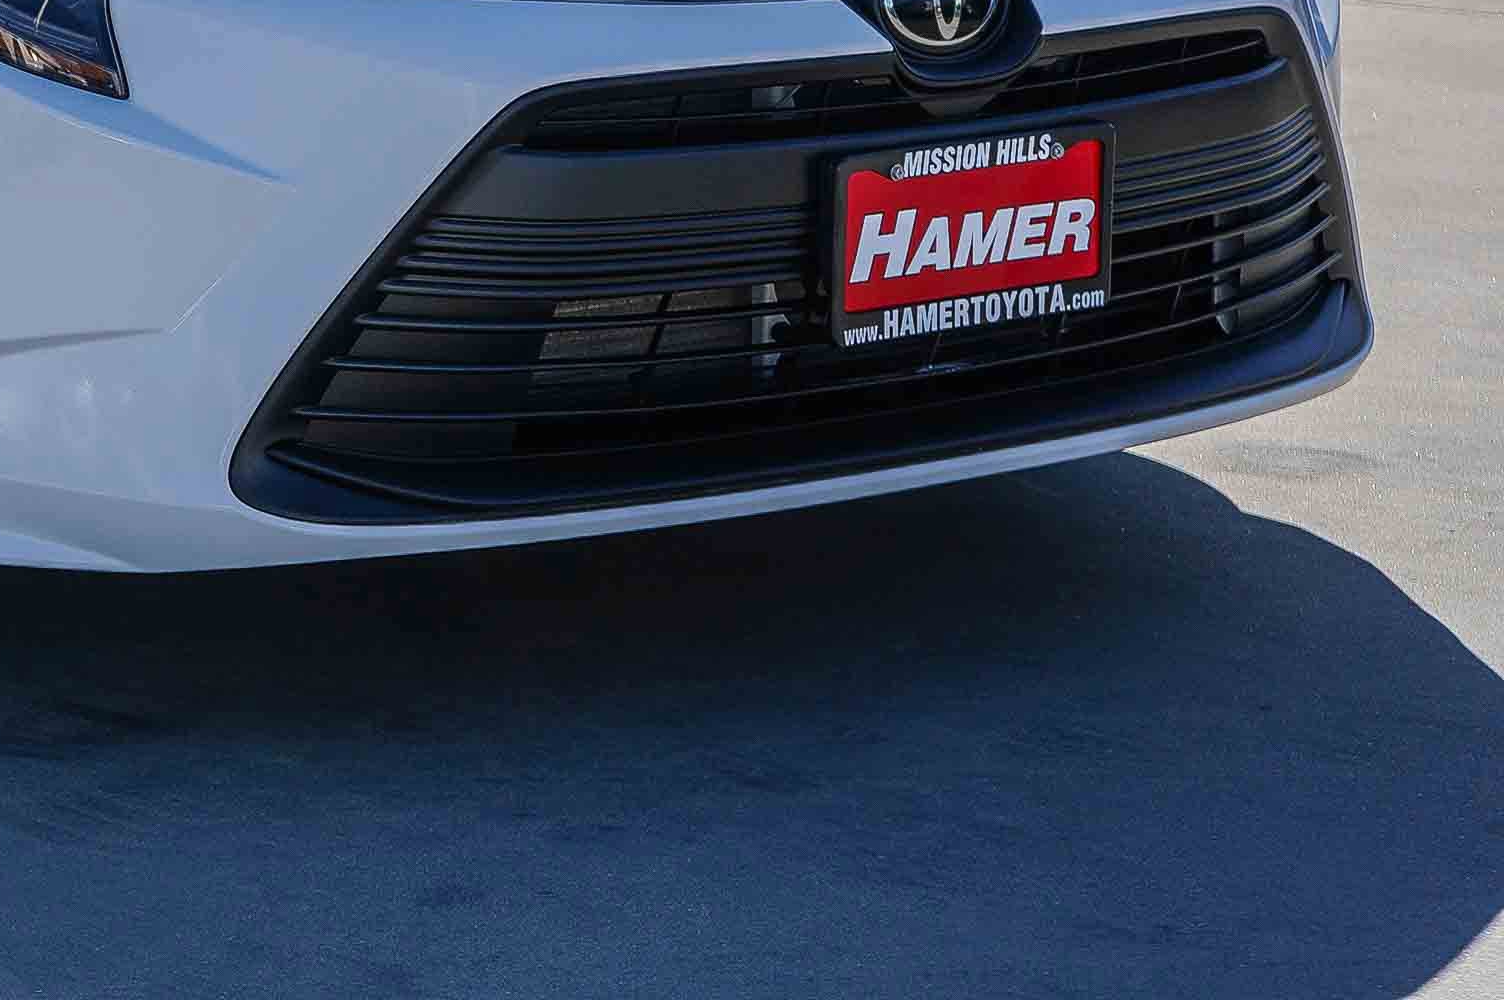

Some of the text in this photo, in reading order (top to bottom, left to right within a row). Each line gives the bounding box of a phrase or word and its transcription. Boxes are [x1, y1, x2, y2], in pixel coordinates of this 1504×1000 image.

[903, 134, 1052, 178] MISSION HILLS
[849, 198, 1095, 283] HAMER
[844, 284, 1105, 346] www.HAMERTOYOTA.com
